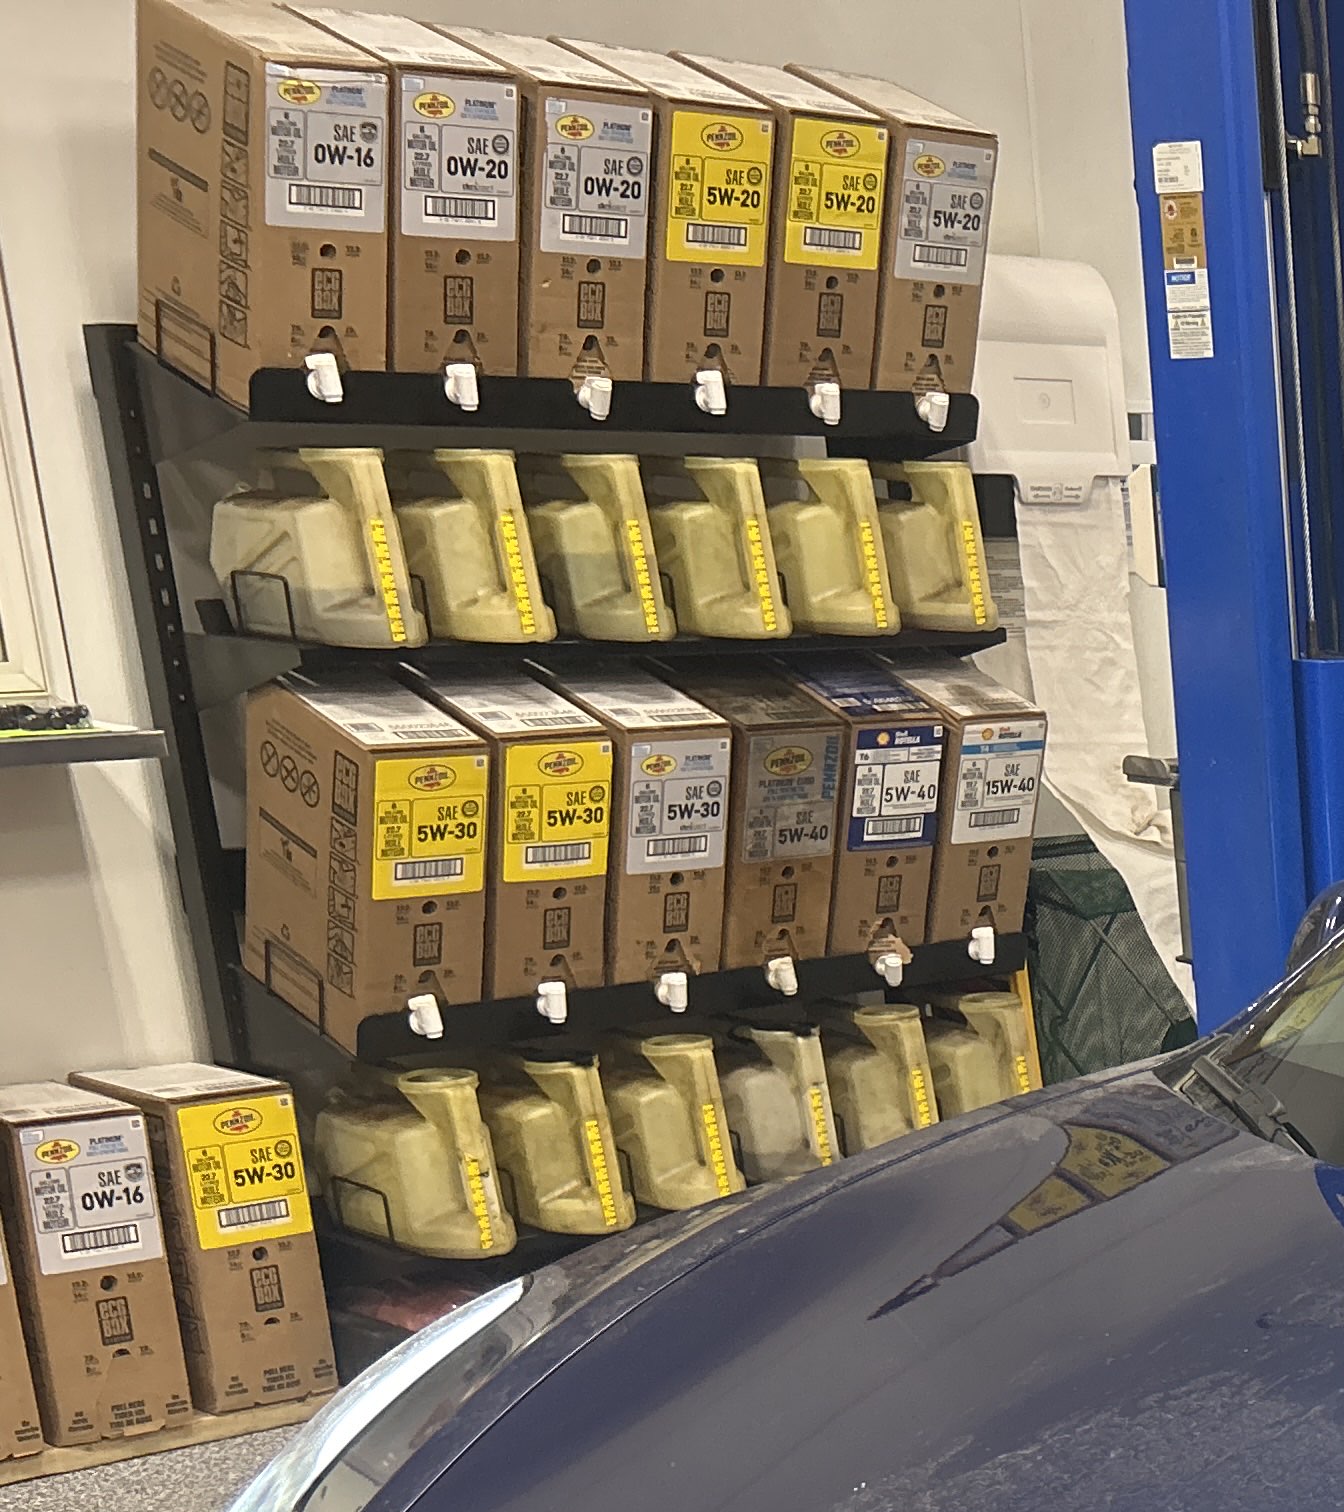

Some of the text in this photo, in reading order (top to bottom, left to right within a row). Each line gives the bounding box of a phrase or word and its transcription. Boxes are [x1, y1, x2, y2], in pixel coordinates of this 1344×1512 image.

[334, 124, 356, 142] SAE
[314, 144, 374, 167] 0W-16
[467, 137, 489, 155] SAE
[447, 156, 508, 179] 0W-20
[604, 159, 624, 176] SAE
[726, 168, 744, 185] SAE
[584, 177, 641, 199] 0W-20
[843, 175, 860, 191] SAE
[707, 187, 760, 208] 5W-20
[824, 192, 875, 213] 5W-20
[950, 194, 968, 210] SAE
[933, 210, 980, 231] 5W-20
[821, 736, 839, 799] PENNZOIL
[904, 770, 921, 784] SAE
[1004, 764, 1021, 777] SAE
[686, 786, 705, 801] SAE
[884, 784, 936, 803] 5W-40
[985, 777, 1035, 796] 15W-40
[566, 791, 587, 807] SAE
[437, 806, 458, 821] SAE
[547, 807, 603, 827] 5W-30
[667, 801, 720, 821] 5W-30
[796, 810, 814, 825] SAE
[417, 822, 477, 842] 5W-30
[778, 825, 828, 844] 5W-40
[250, 1147, 273, 1164] SAE
[98, 1170, 123, 1187] SAE
[233, 1162, 295, 1187] 5W-30
[81, 1186, 144, 1211] 0W-16
